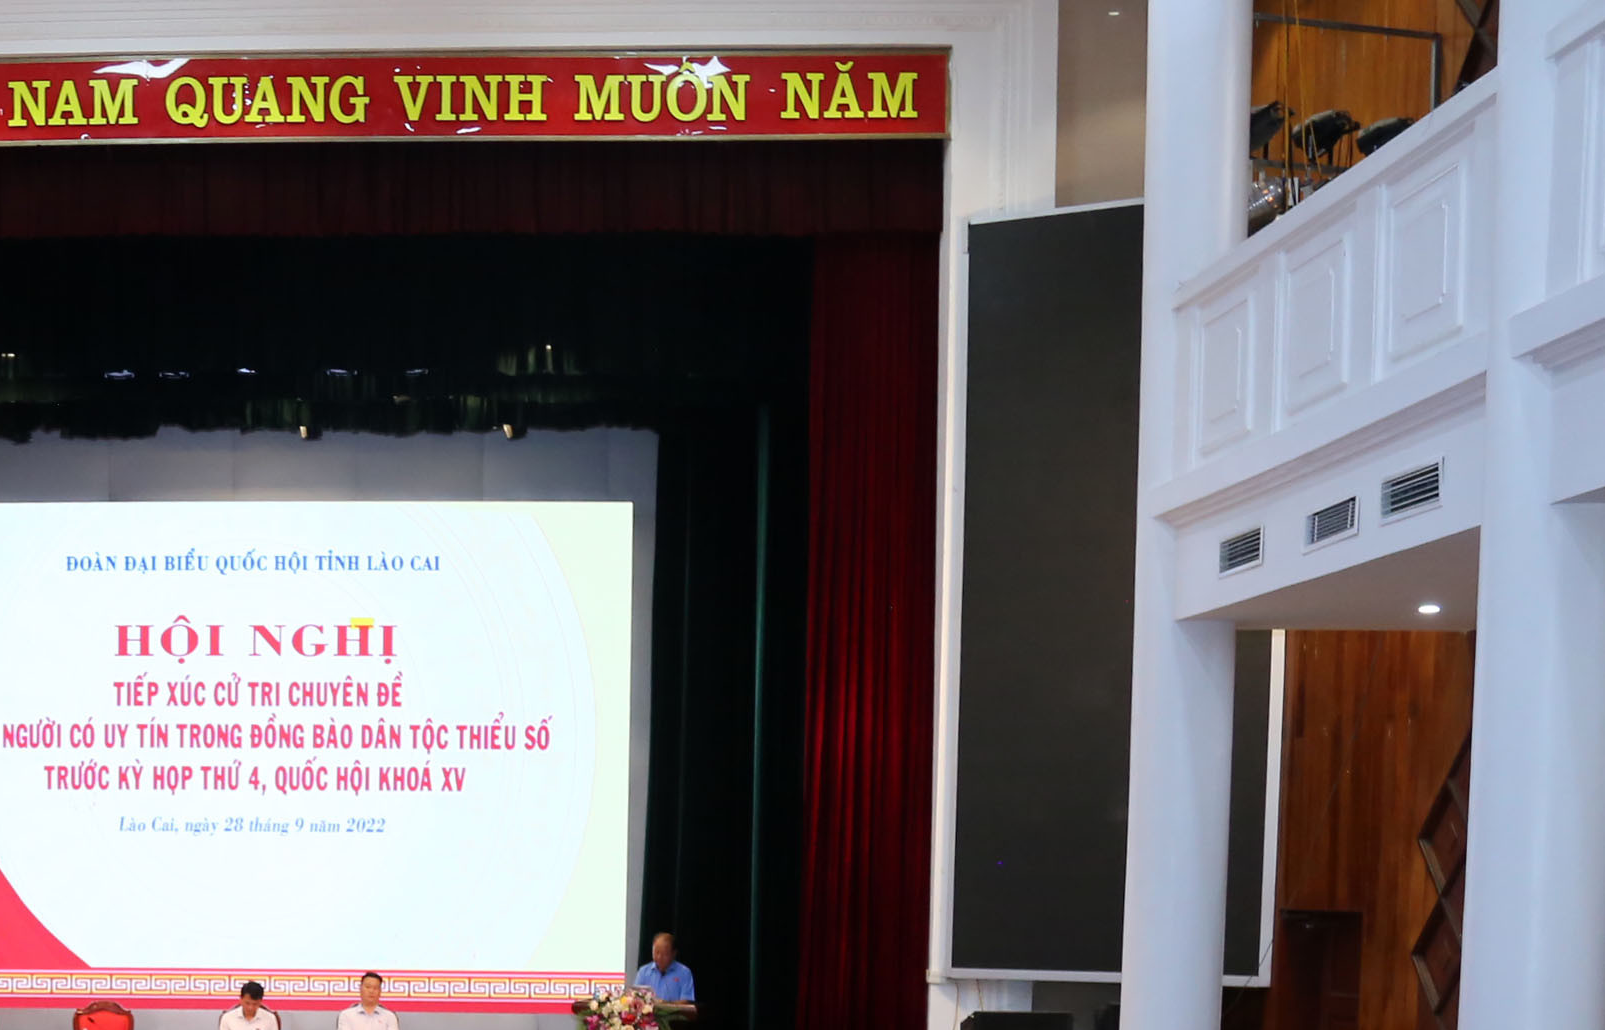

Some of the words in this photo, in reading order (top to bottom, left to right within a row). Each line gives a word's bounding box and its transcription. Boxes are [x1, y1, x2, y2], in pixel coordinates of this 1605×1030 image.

[7, 77, 139, 127] NAM
[166, 74, 371, 128] QUANG
[394, 74, 549, 122] VINH
[574, 62, 749, 123] MUÔN
[781, 62, 919, 120] NĂM
[66, 550, 117, 572] ĐOÀN
[125, 555, 157, 574] ĐẠI
[164, 547, 208, 572] BIỂU
[215, 548, 267, 575] QUỐC
[274, 551, 308, 575] HỘI
[315, 549, 360, 572] TỈNH
[367, 551, 403, 572] LÀO
[410, 555, 440, 572] CAI
[114, 615, 225, 665] HỘI
[249, 622, 398, 666] NGHỊ
[113, 672, 159, 707] TIẾP
[167, 675, 206, 707] XÚC
[213, 672, 242, 707] CỬ
[247, 681, 280, 707] TRI
[288, 675, 369, 707] CHUYÊN
[376, 671, 403, 707] ĐỀ
[2, 717, 62, 748] NGƯỜI
[69, 717, 95, 748] CÓ
[104, 723, 129, 748] UY
[136, 717, 169, 748] TÍN
[176, 723, 242, 749] TRONG
[250, 713, 305, 749] ĐỒNG
[312, 717, 353, 749] BÀO
[361, 717, 402, 750] DÂN
[409, 718, 449, 754] TỘC
[456, 712, 516, 750] THIỂU
[524, 715, 552, 750] SỐ
[44, 759, 110, 790] TRƯỚC
[118, 759, 144, 790] KỲ
[153, 765, 193, 795] HỌP
[200, 759, 242, 790] THỨ
[248, 766, 267, 796] 4,
[275, 756, 328, 795] QUỐC
[336, 760, 370, 796] HỘI
[379, 760, 432, 791] KHOÁ
[441, 766, 466, 791] XV
[119, 816, 146, 833] Lào
[151, 817, 179, 834] Cai,
[184, 818, 217, 837] ngày
[223, 816, 244, 833] 28
[248, 817, 289, 837] tháng
[294, 817, 305, 833] 9
[309, 819, 340, 833] năm
[346, 817, 387, 834] 2022
